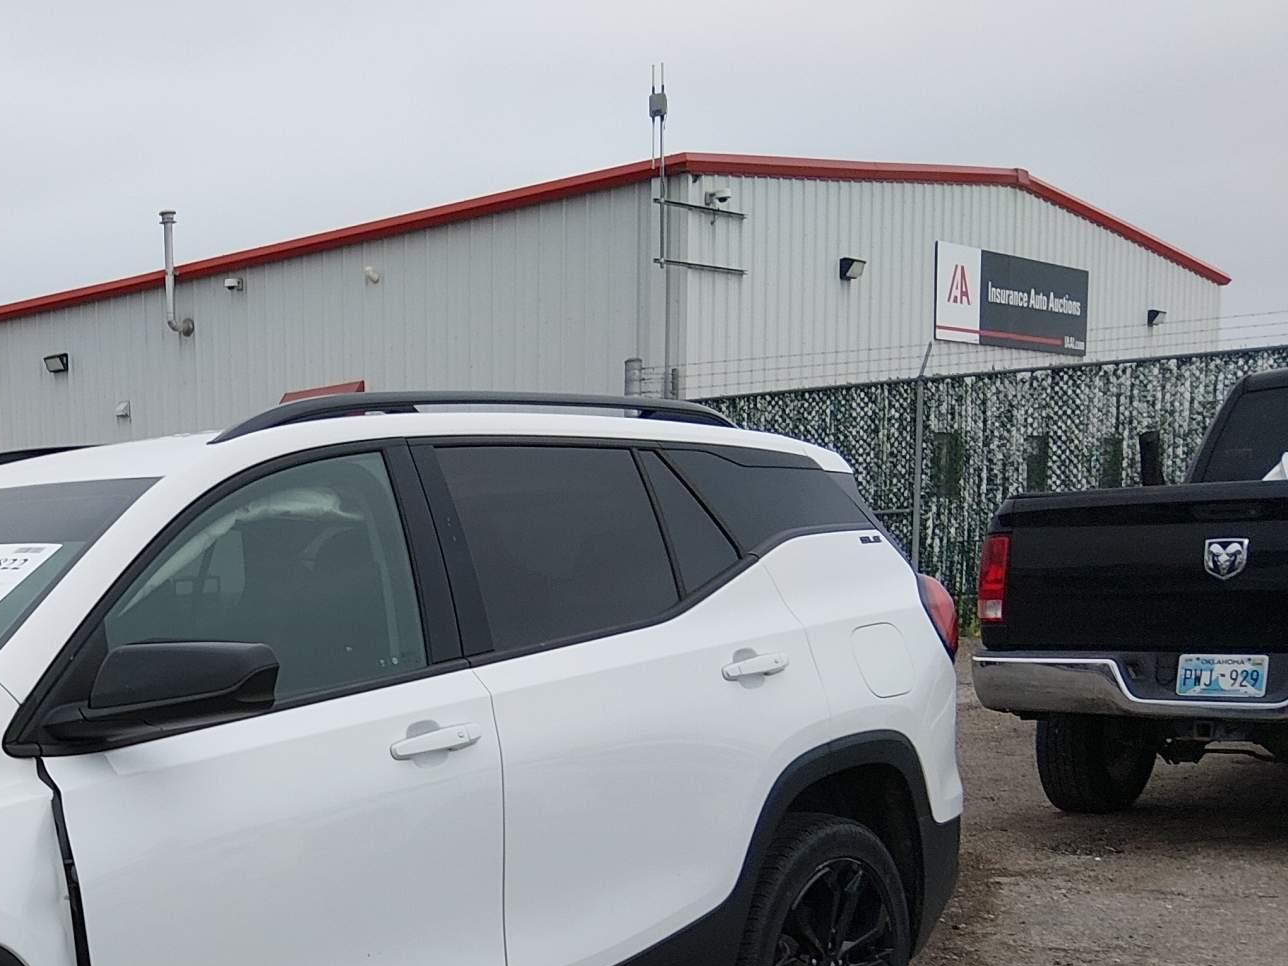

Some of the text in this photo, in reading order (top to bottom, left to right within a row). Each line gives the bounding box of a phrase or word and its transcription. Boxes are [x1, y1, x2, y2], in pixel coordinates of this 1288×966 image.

[988, 281, 1081, 316] Insurance Auto Auctions
